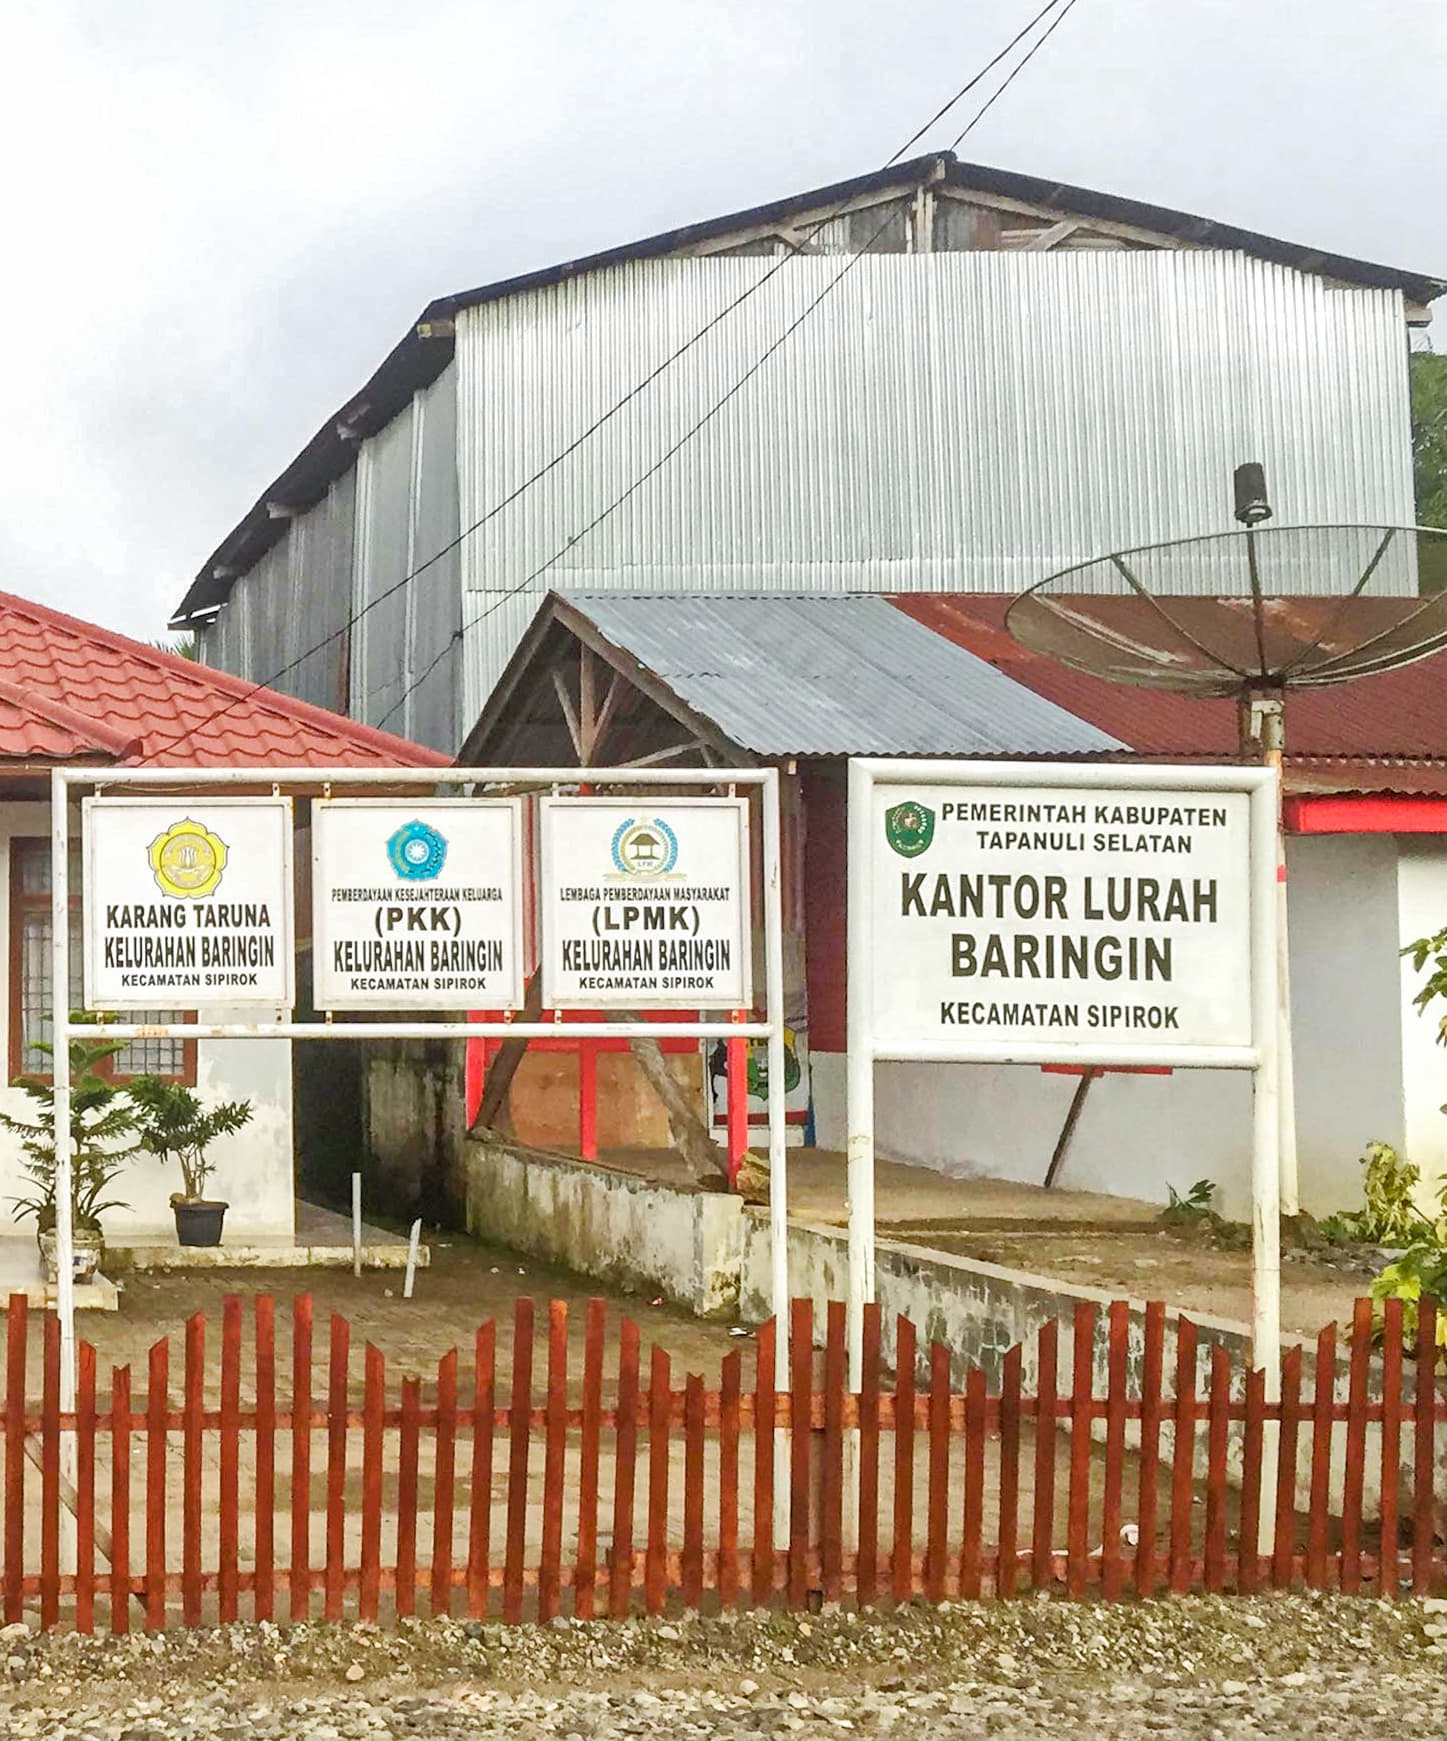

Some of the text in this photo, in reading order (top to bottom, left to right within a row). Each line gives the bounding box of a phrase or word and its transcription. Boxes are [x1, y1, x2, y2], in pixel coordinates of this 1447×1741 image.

[942, 803, 1227, 827] PEMERINTAH KABUPATEN
[976, 831, 1192, 854] TAPANULI SELATAN
[332, 887, 503, 902] PEMBERDAYAAN KESEJAHTERAAN KELUARGA
[560, 887, 730, 901] LEMBAGA PEMBERDAYAAN MASYARAKAT
[901, 872, 1217, 923] KANTOR LURAH
[107, 903, 271, 929] KARANG TARUNA
[375, 906, 461, 938] (PKK)
[592, 905, 700, 937] (LPMK)
[105, 935, 274, 969] KELURAHAN BARINGIN
[334, 940, 503, 973] KELURAHAN BARINGIN
[562, 939, 730, 972] KELURAHAN BARINGIN
[951, 933, 1172, 982] BARINGIN
[121, 973, 257, 987] KECAMATAN SIPIROK
[351, 977, 486, 990] KECAMATAN SIPIROK
[579, 976, 714, 989] KECAMATAN SIPIROK
[940, 1001, 1179, 1029] KECAMATAN SIPIROK
